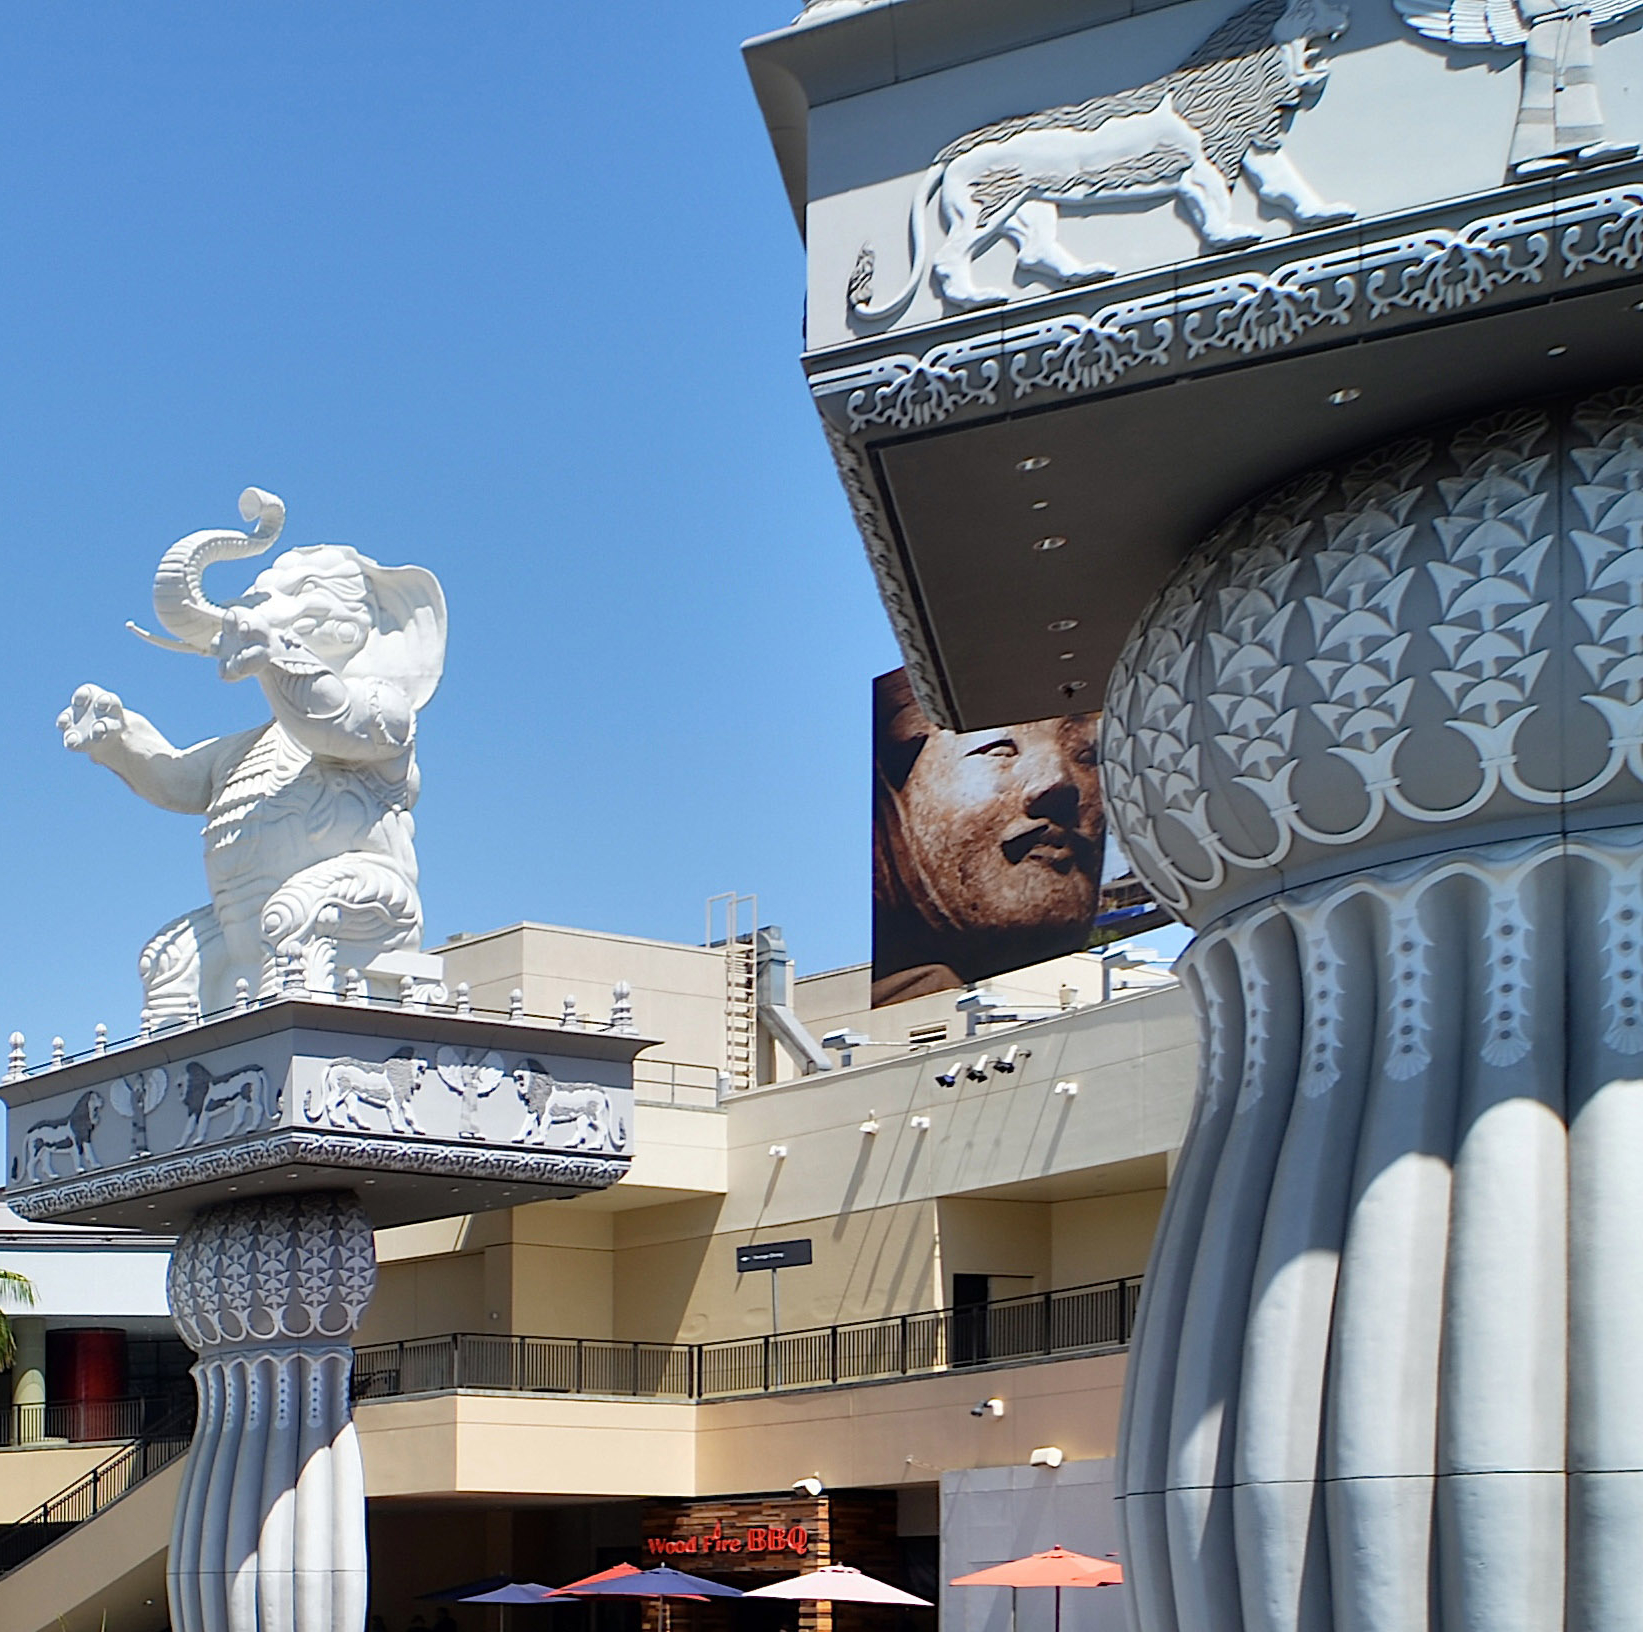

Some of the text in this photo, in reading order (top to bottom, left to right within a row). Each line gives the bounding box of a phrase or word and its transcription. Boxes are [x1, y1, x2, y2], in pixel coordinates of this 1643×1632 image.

[648, 1519, 807, 1555] Wood Fire BBQ
